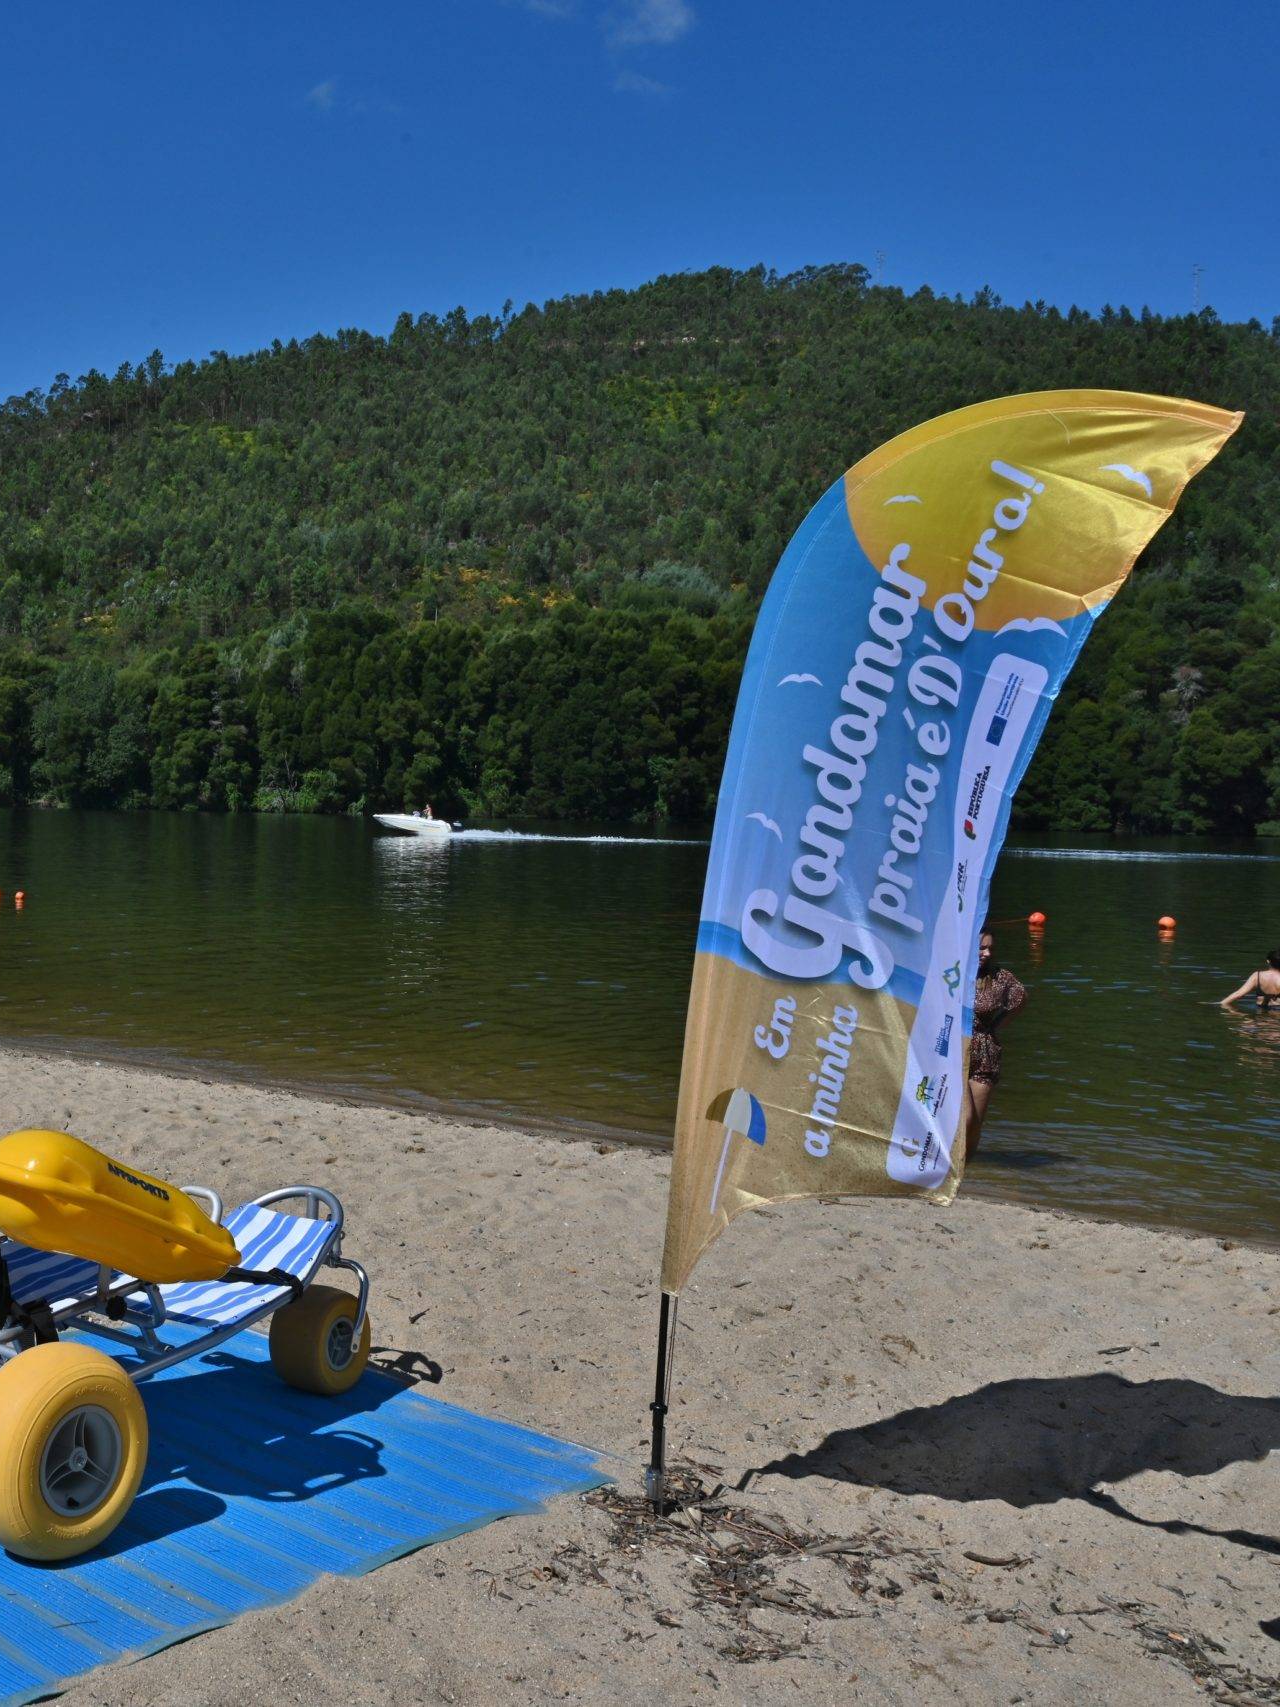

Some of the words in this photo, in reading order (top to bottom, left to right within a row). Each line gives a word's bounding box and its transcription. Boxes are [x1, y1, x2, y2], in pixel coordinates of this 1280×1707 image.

[908, 460, 1044, 708] D'Ouro!
[903, 707, 951, 756] é
[741, 543, 926, 990] Gondomar
[967, 773, 982, 817] REPÚBLICA
[973, 766, 991, 820] PORTUGUESA
[868, 762, 940, 933] praia
[754, 996, 797, 1059] Em
[808, 1004, 858, 1127] minha
[804, 1129, 830, 1158] a
